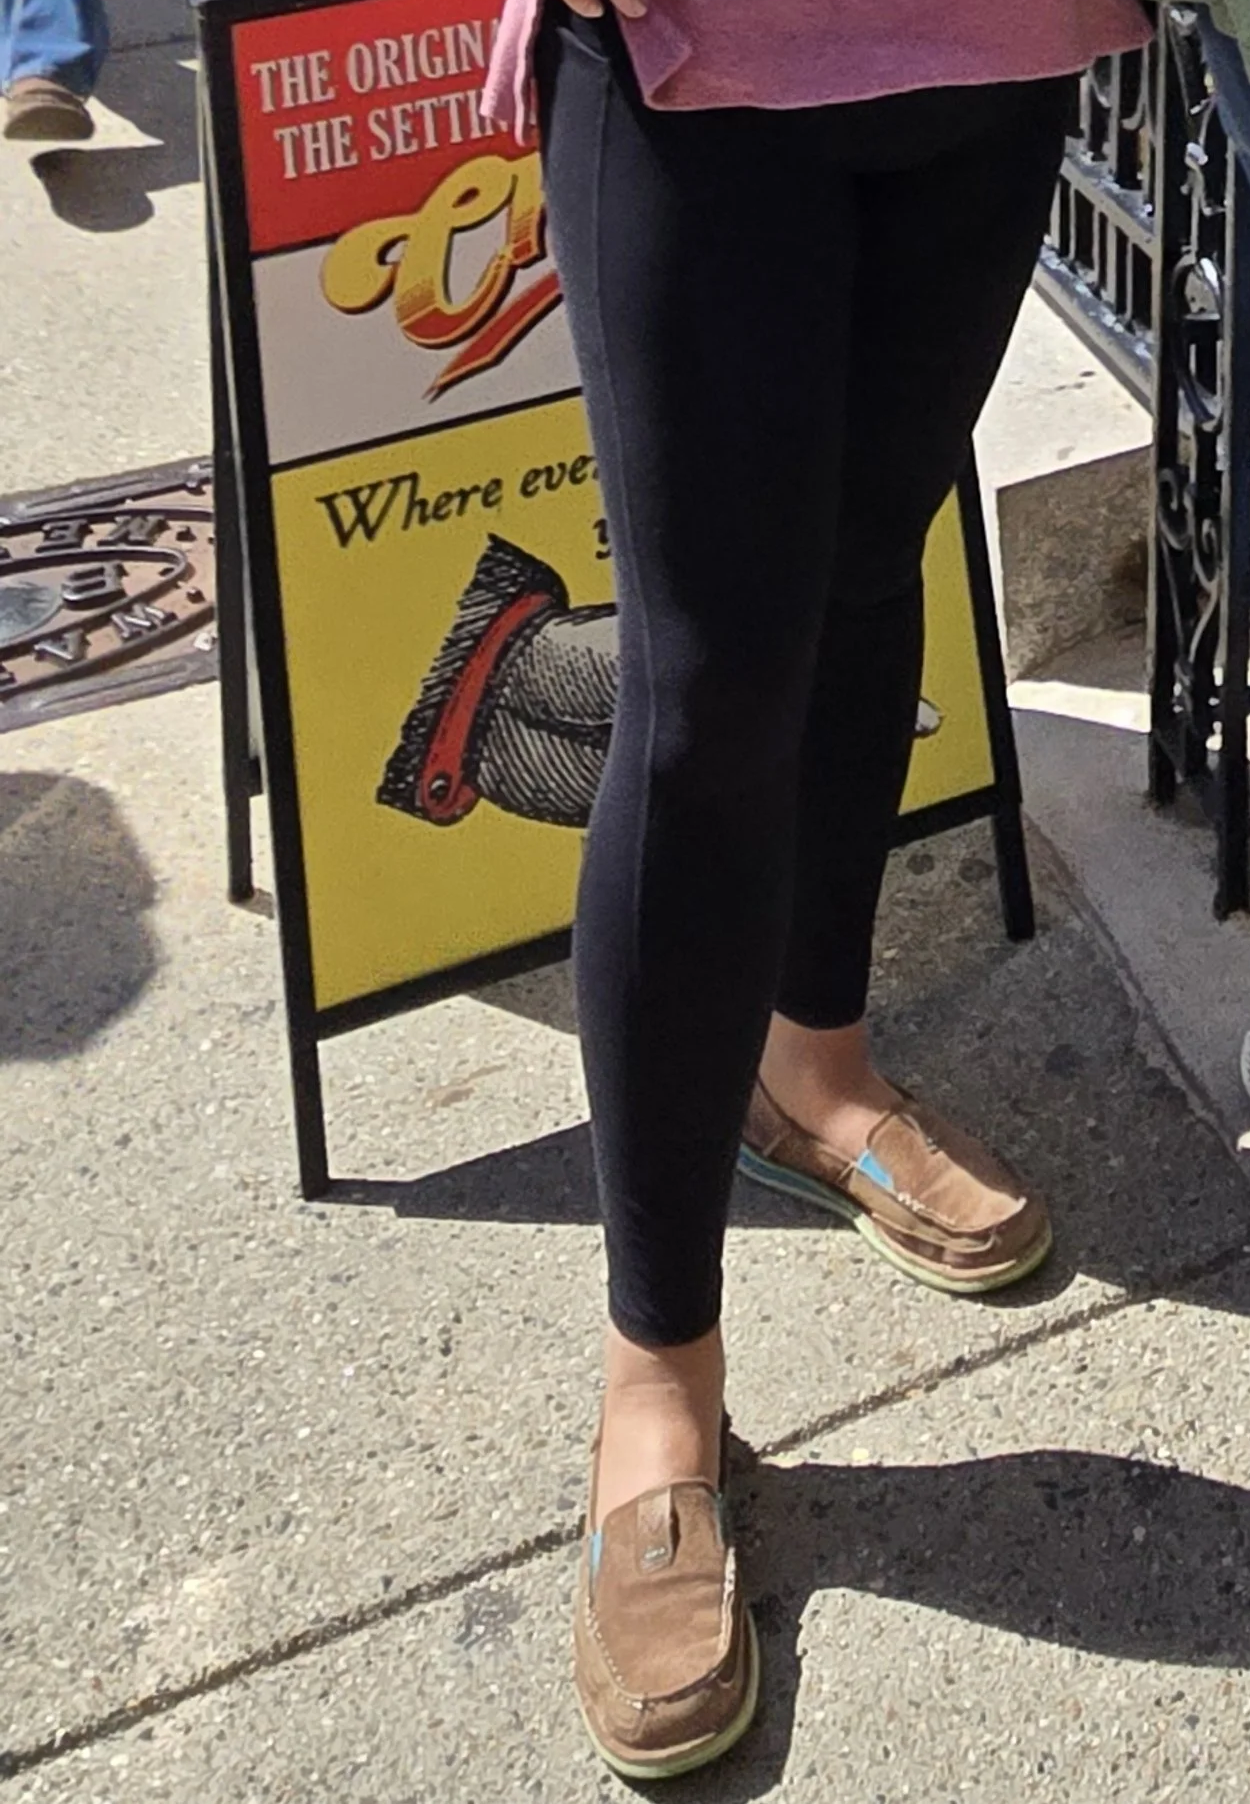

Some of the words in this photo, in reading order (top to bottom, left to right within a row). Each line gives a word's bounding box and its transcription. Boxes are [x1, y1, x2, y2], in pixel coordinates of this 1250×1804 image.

[250, 49, 336, 114] THE
[345, 17, 502, 94] ORIGIN
[273, 114, 359, 180] THE
[367, 88, 537, 162] SETTI
[0, 515, 170, 560] ME
[314, 470, 503, 548] Where
[519, 454, 601, 499] eve
[0, 603, 172, 684] WA
